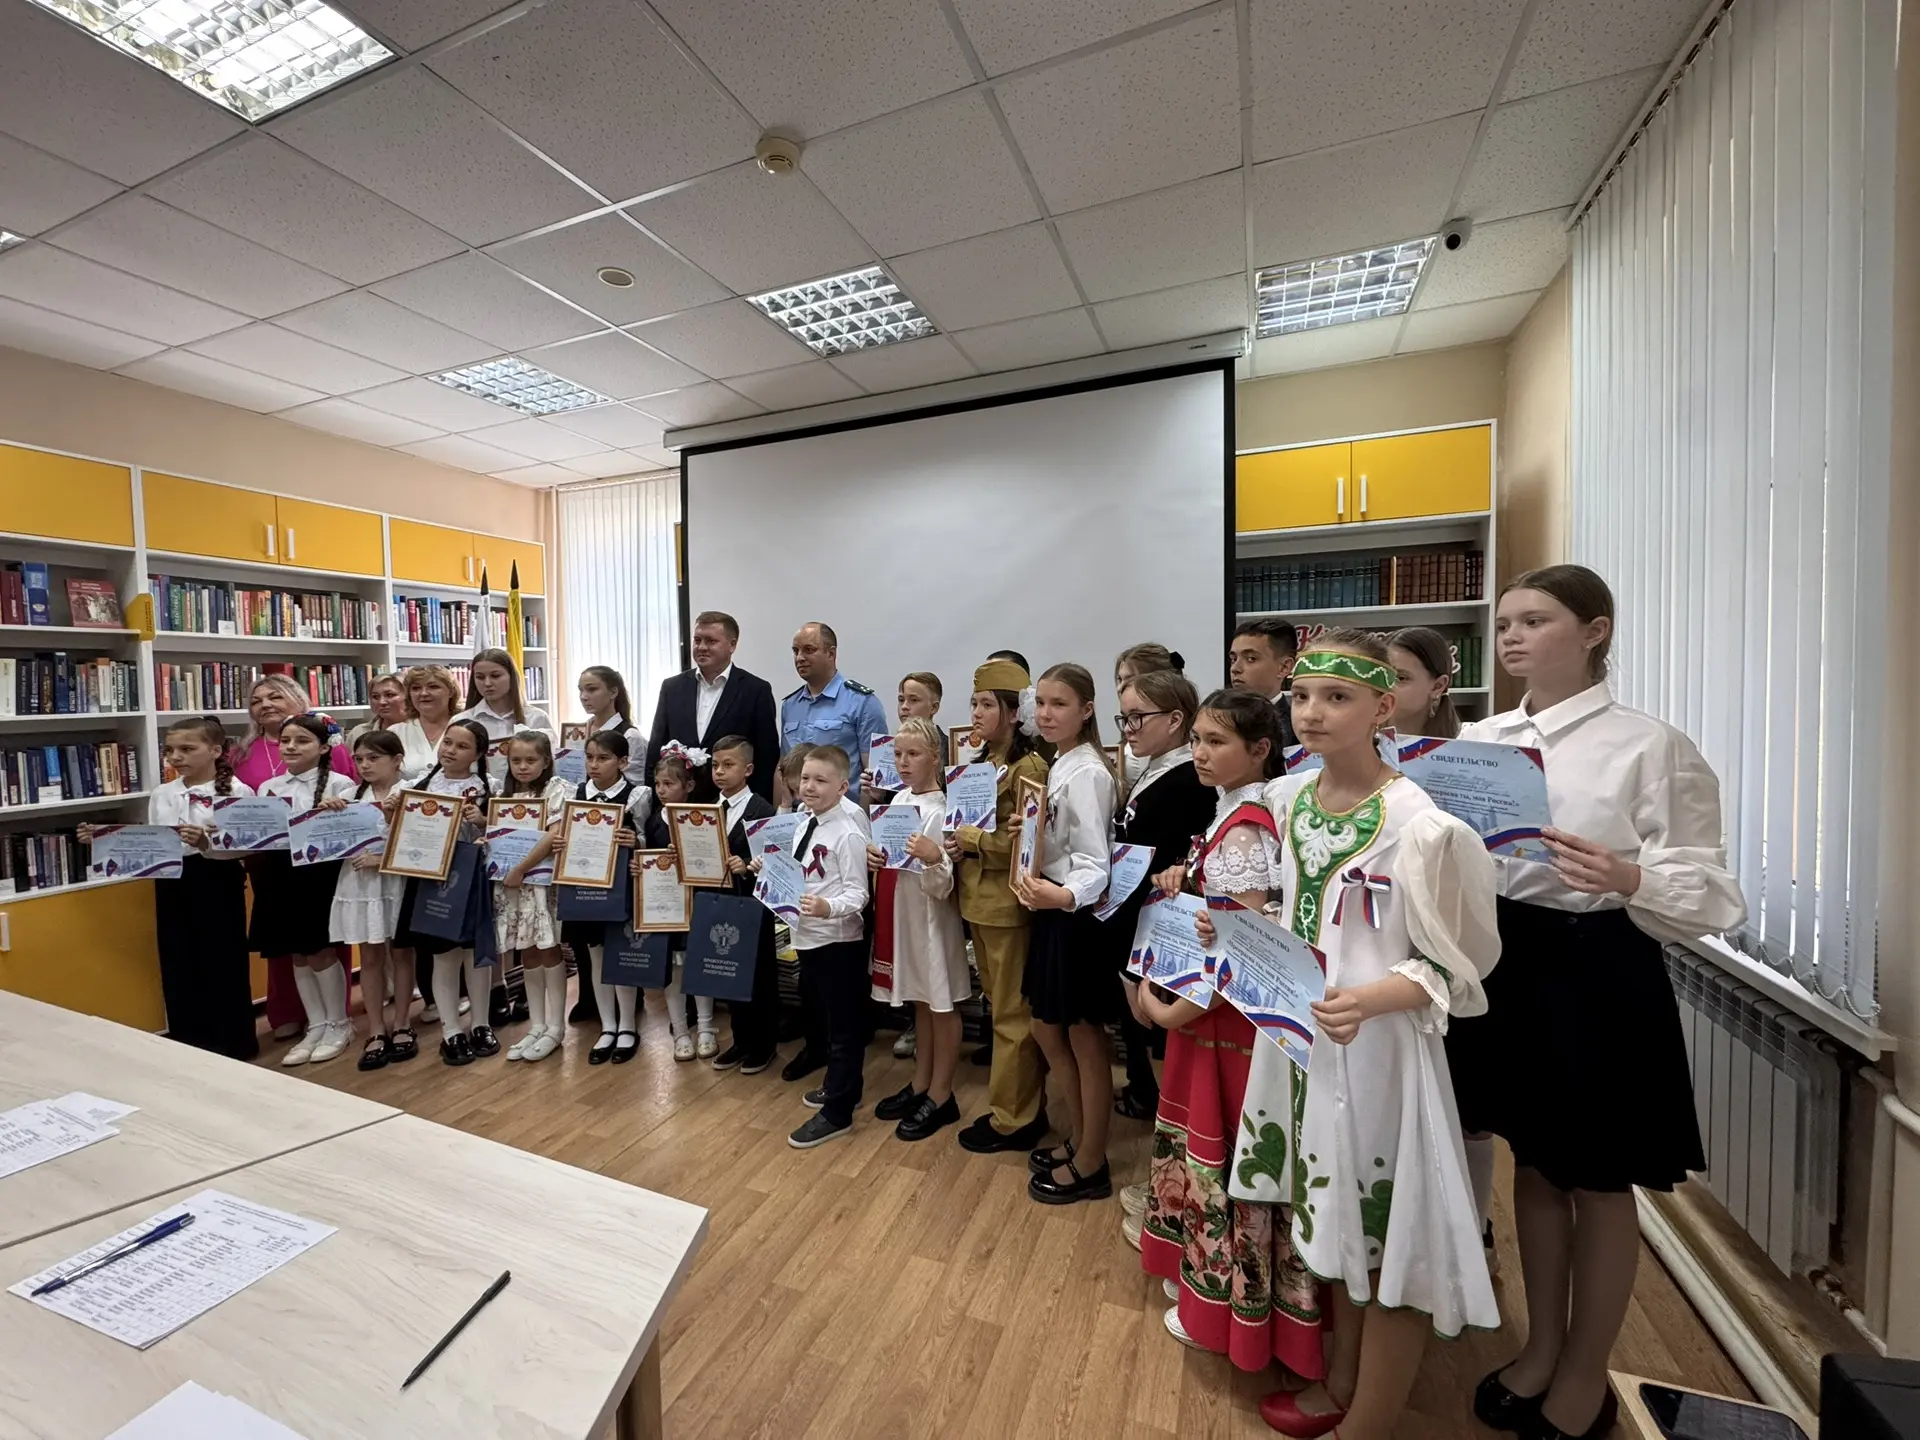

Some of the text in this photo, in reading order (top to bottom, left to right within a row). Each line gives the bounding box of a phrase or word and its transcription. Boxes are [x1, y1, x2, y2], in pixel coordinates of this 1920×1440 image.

[117, 669, 125, 706] ПРАЗДНИКИ
[1430, 754, 1499, 768] СВИДЕТЕЛЬСТВО
[1160, 902, 1196, 918] СВИДЕТЕЛЬСТВ
[1234, 913, 1290, 953] СВИДЕТЕЛЬСТВО
